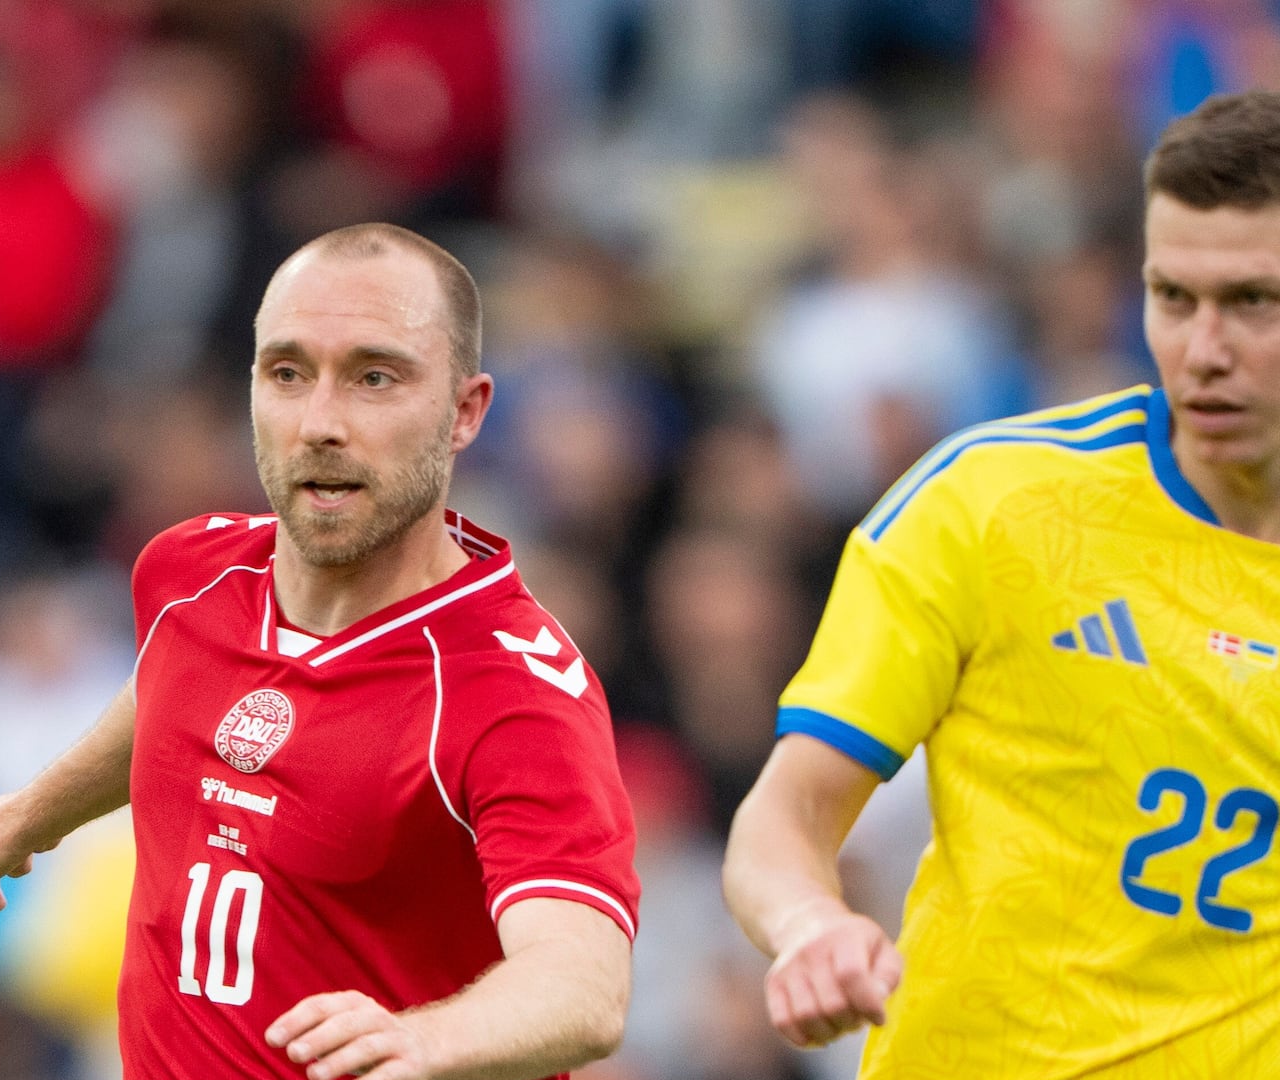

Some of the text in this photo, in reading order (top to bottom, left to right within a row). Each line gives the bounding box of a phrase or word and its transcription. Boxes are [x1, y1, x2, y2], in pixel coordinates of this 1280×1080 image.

[218, 708, 244, 755] DANSK
[229, 755, 254, 770] 1889
[216, 781, 278, 816] hummel
[1120, 767, 1280, 934] 22
[178, 862, 264, 1006] 10
